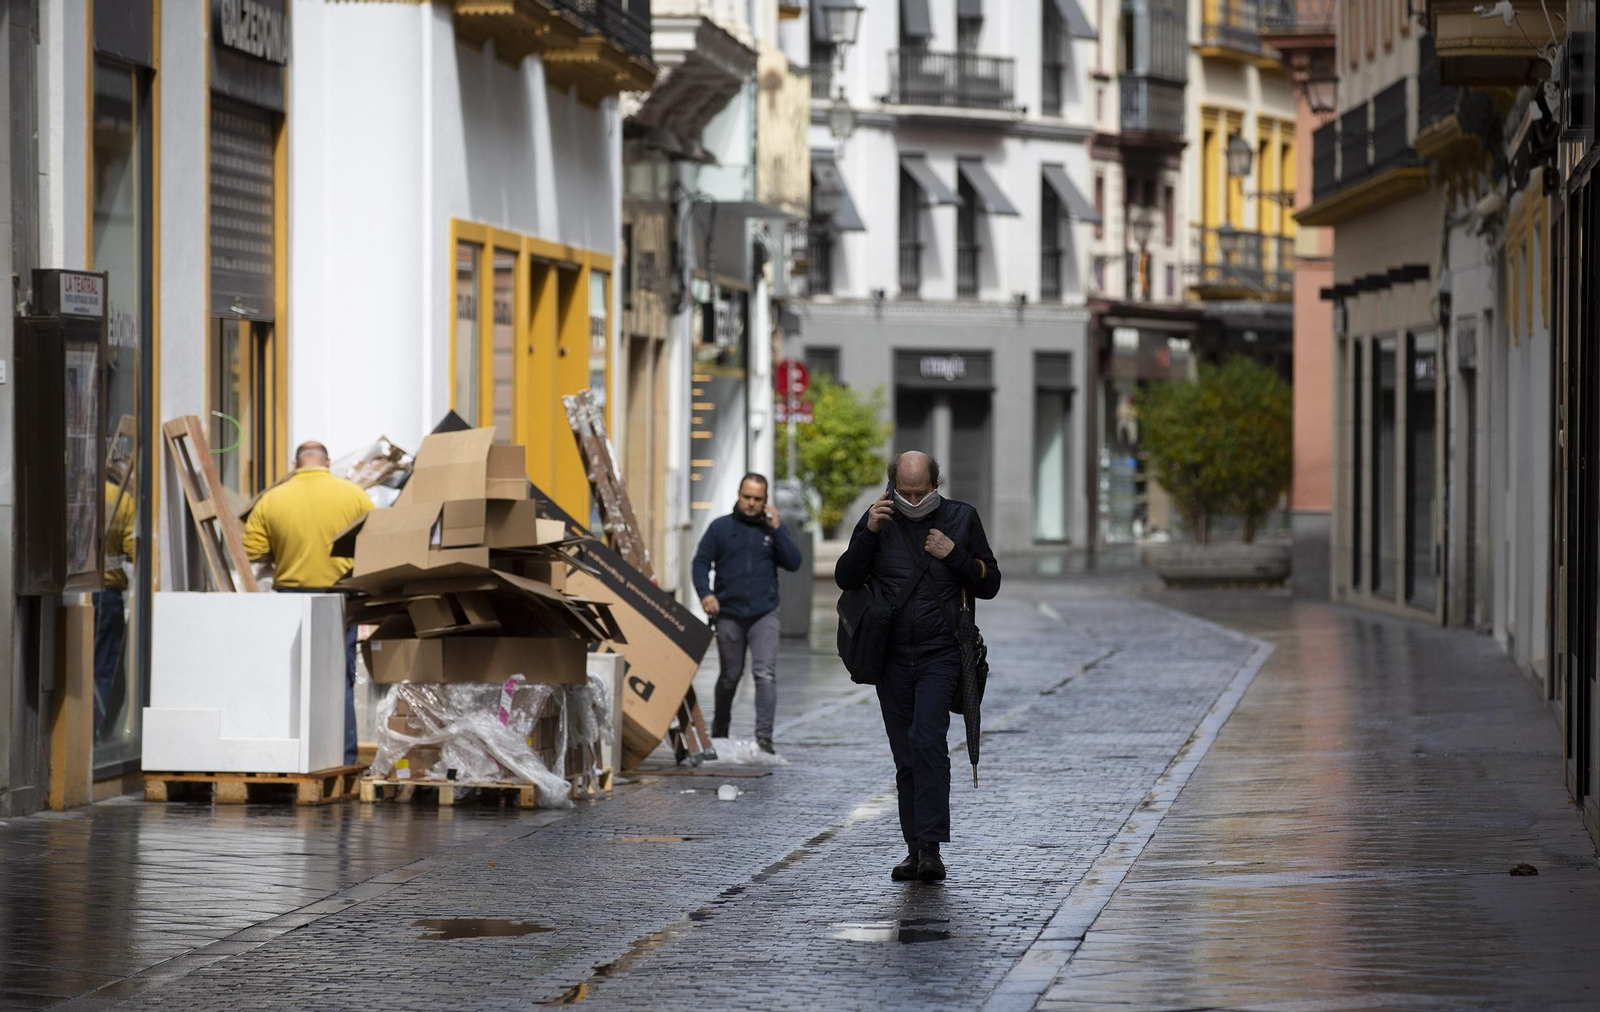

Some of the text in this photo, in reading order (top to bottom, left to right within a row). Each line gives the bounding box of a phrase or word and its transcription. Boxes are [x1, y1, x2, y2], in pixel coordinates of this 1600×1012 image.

[64, 273, 98, 296] LA TEATRAL
[626, 581, 685, 632] Professional
